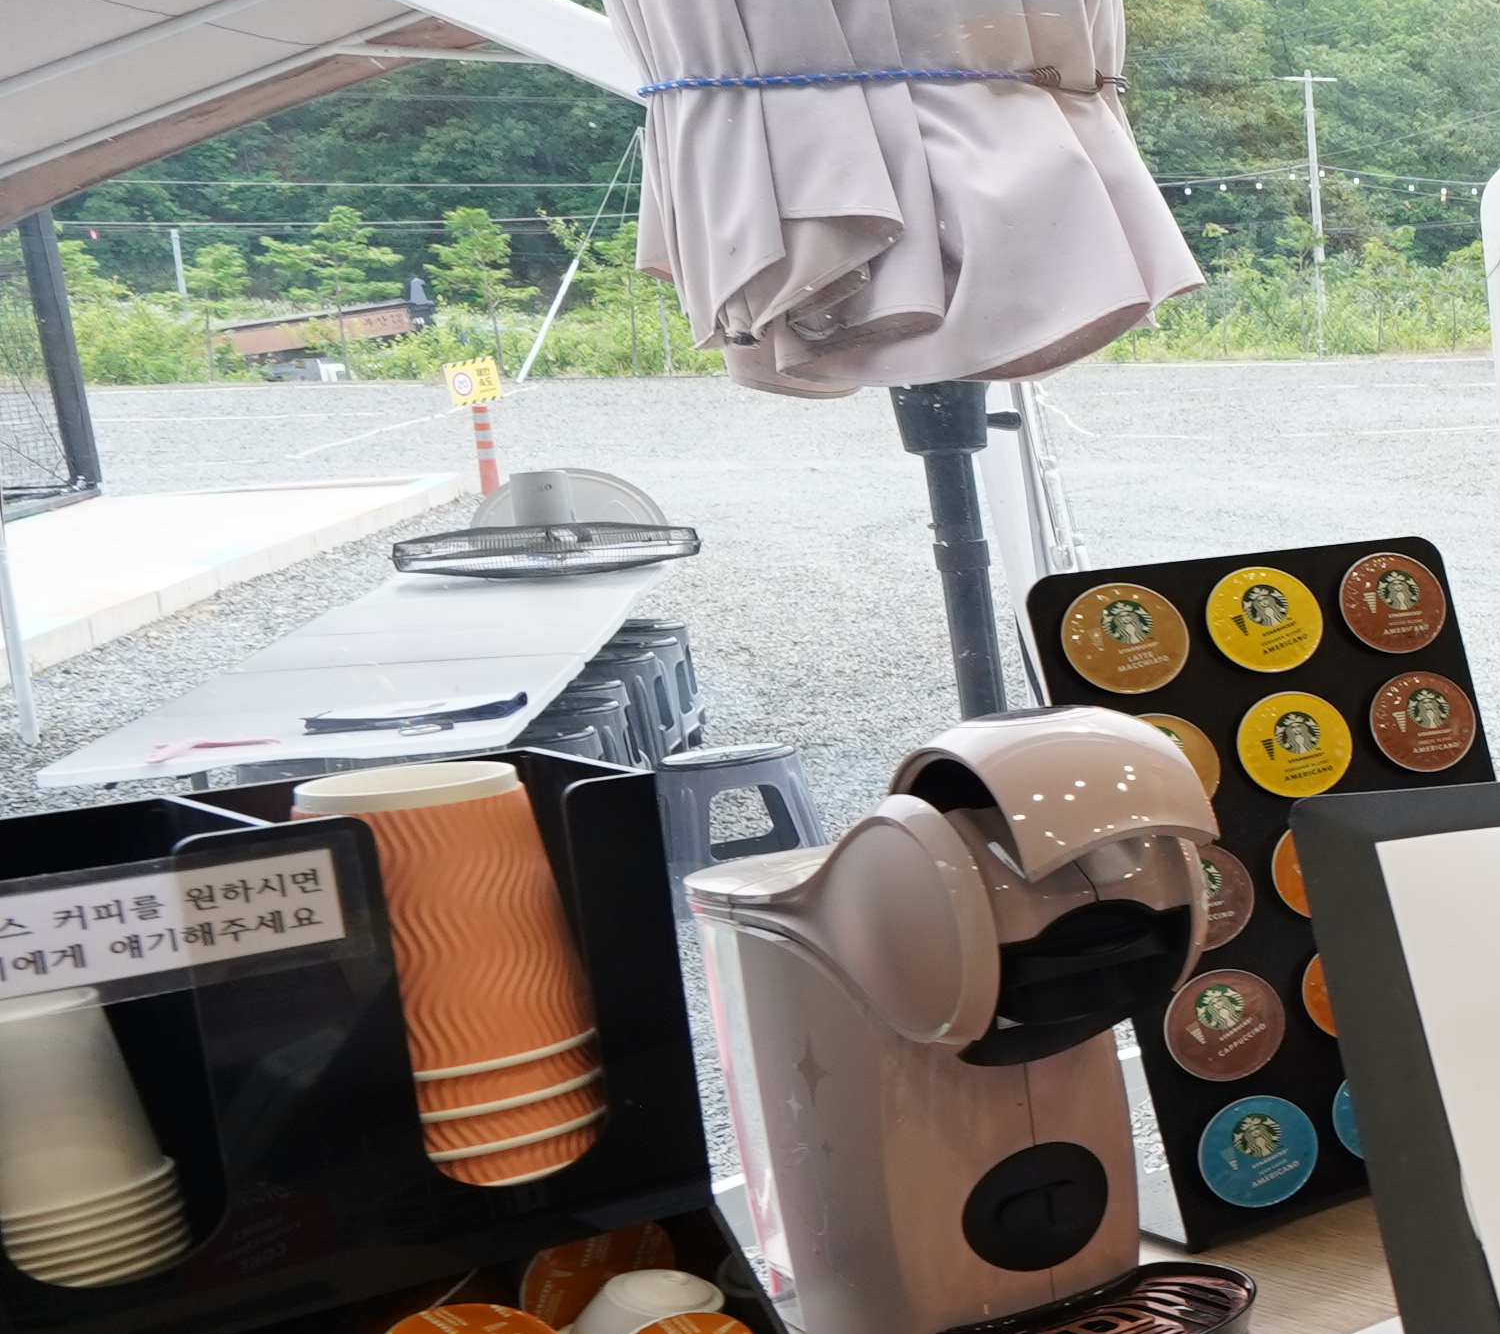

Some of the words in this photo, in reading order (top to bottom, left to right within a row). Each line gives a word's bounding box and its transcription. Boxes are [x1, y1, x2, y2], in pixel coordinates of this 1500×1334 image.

[1127, 651, 1153, 662] LATTE
[1262, 633, 1308, 655] AMERICANO
[1117, 655, 1170, 672] MACCHIATO
[52, 895, 166, 931] 커피를
[185, 868, 323, 910] 원하시면
[0, 944, 88, 981] 에게
[109, 907, 323, 960] 얘기해주세요
[1218, 1022, 1266, 1058] CAPPUCCINO
[1252, 1160, 1300, 1189] AMERICANO
